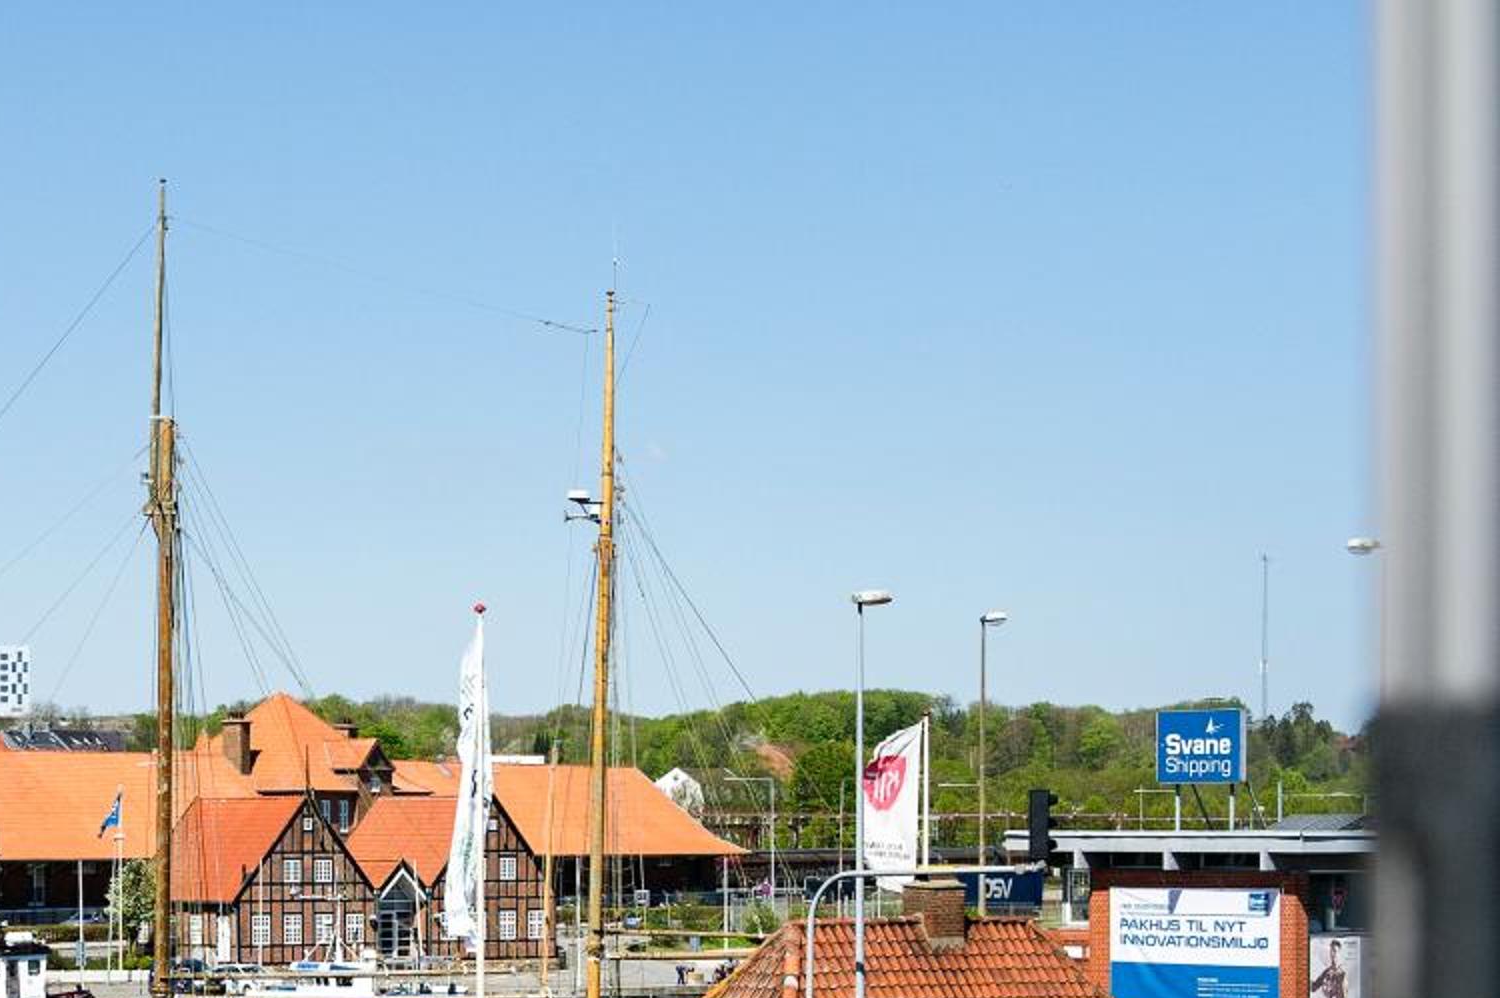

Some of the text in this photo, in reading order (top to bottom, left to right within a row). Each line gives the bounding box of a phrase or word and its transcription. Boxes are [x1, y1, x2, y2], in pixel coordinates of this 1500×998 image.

[1165, 733, 1231, 755] Svane
[1165, 756, 1231, 777] Shipping
[984, 878, 1012, 898] DSV
[1120, 918, 1246, 933] PAKHUS TIL NYT
[1120, 934, 1269, 949] INNOVATIONSMILJØ
